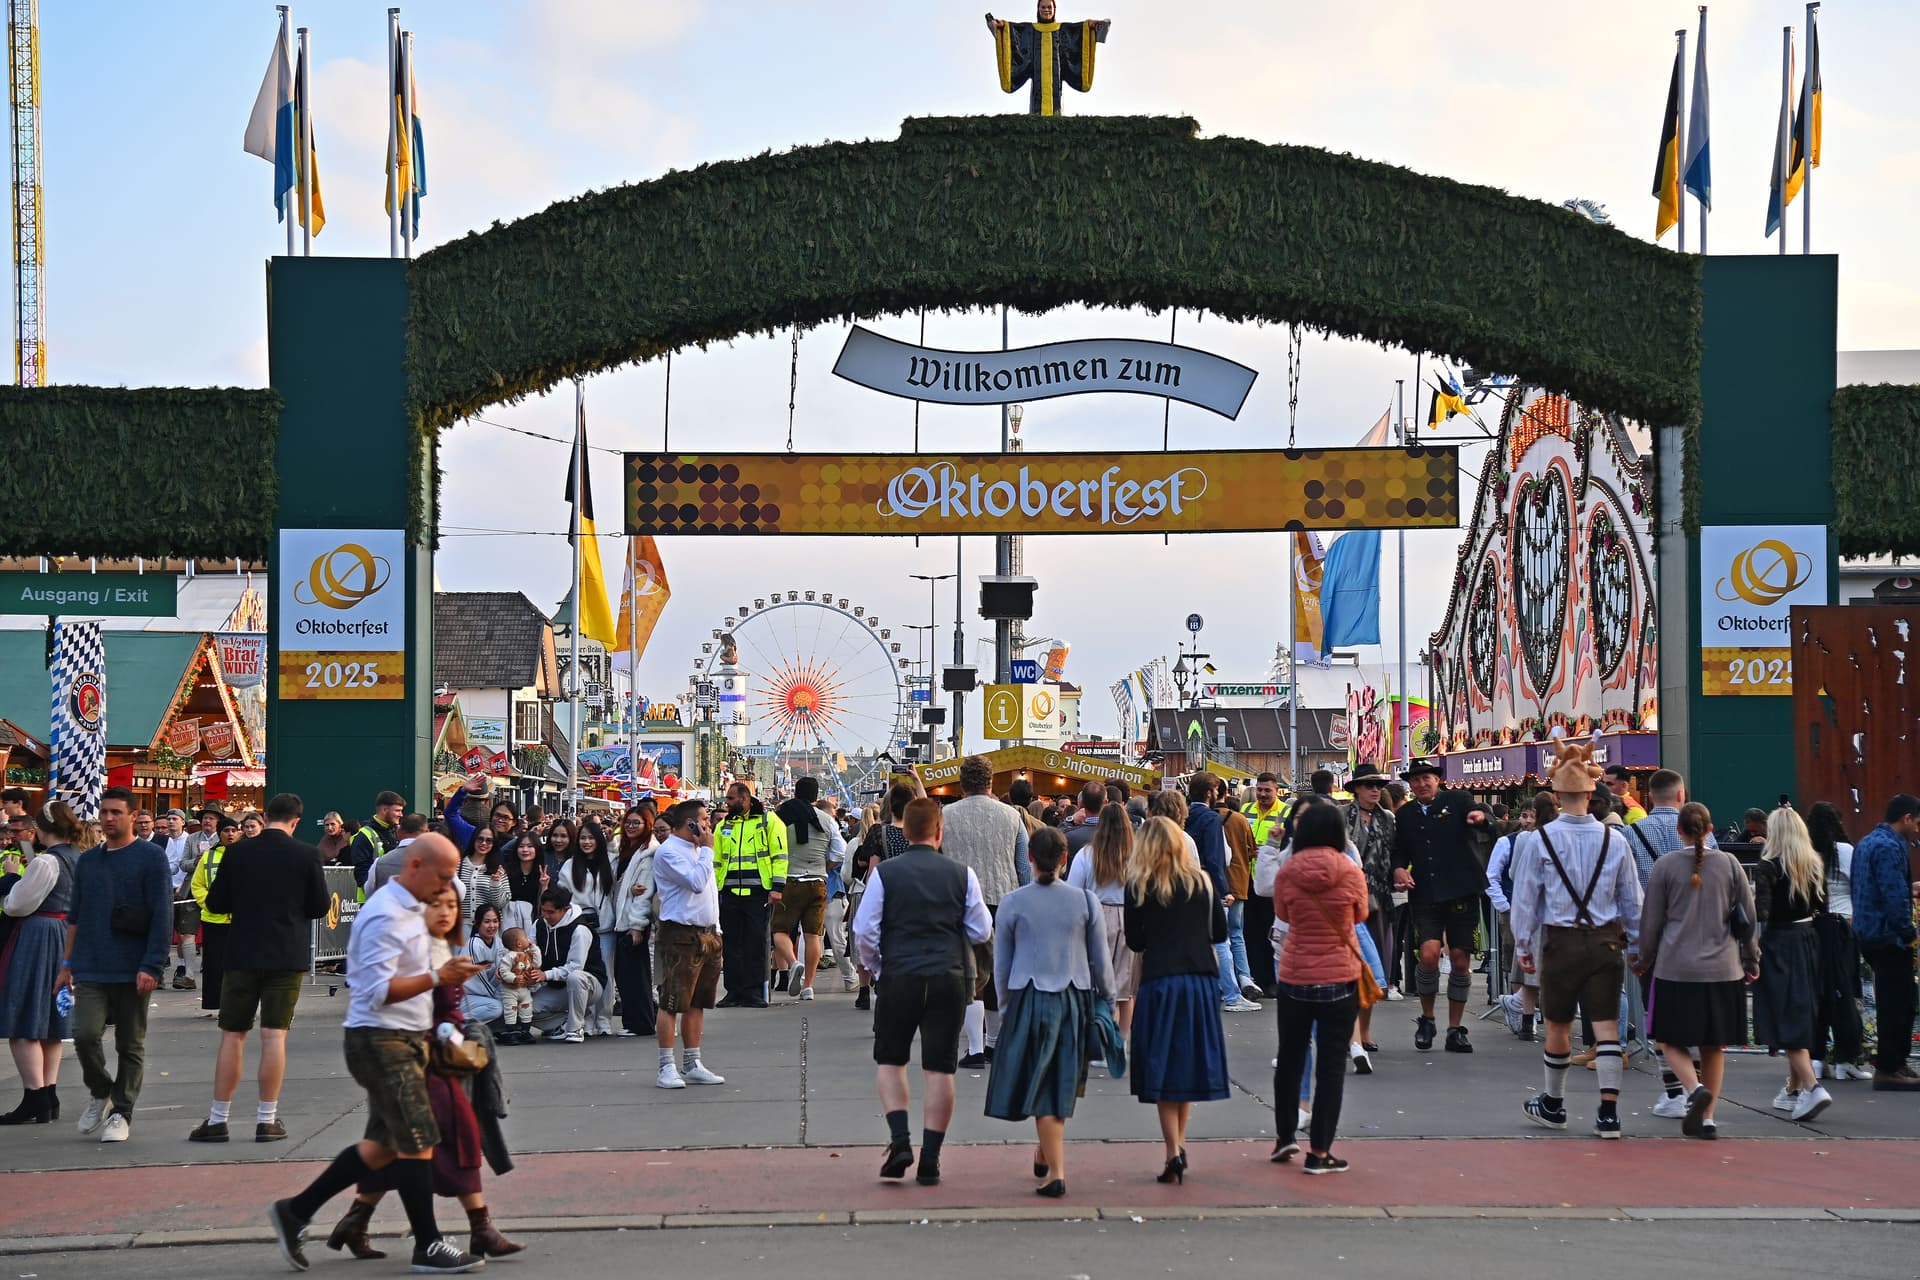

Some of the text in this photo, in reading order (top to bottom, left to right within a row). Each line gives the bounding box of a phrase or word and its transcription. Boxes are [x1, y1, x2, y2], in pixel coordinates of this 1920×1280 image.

[906, 355, 1182, 392] Willkommen zum
[876, 461, 1208, 525] Oktoberfest
[20, 586, 149, 605] Ausgang / Exit
[295, 618, 390, 638] Oktoberfest
[1718, 615, 1792, 634] Oktoberf
[223, 647, 261, 662] Brat-
[304, 661, 379, 688] 2025
[1013, 666, 1035, 679] WC
[1207, 684, 1291, 696] vinzenzmur
[924, 765, 961, 781] Souv
[1062, 756, 1143, 784] Information
